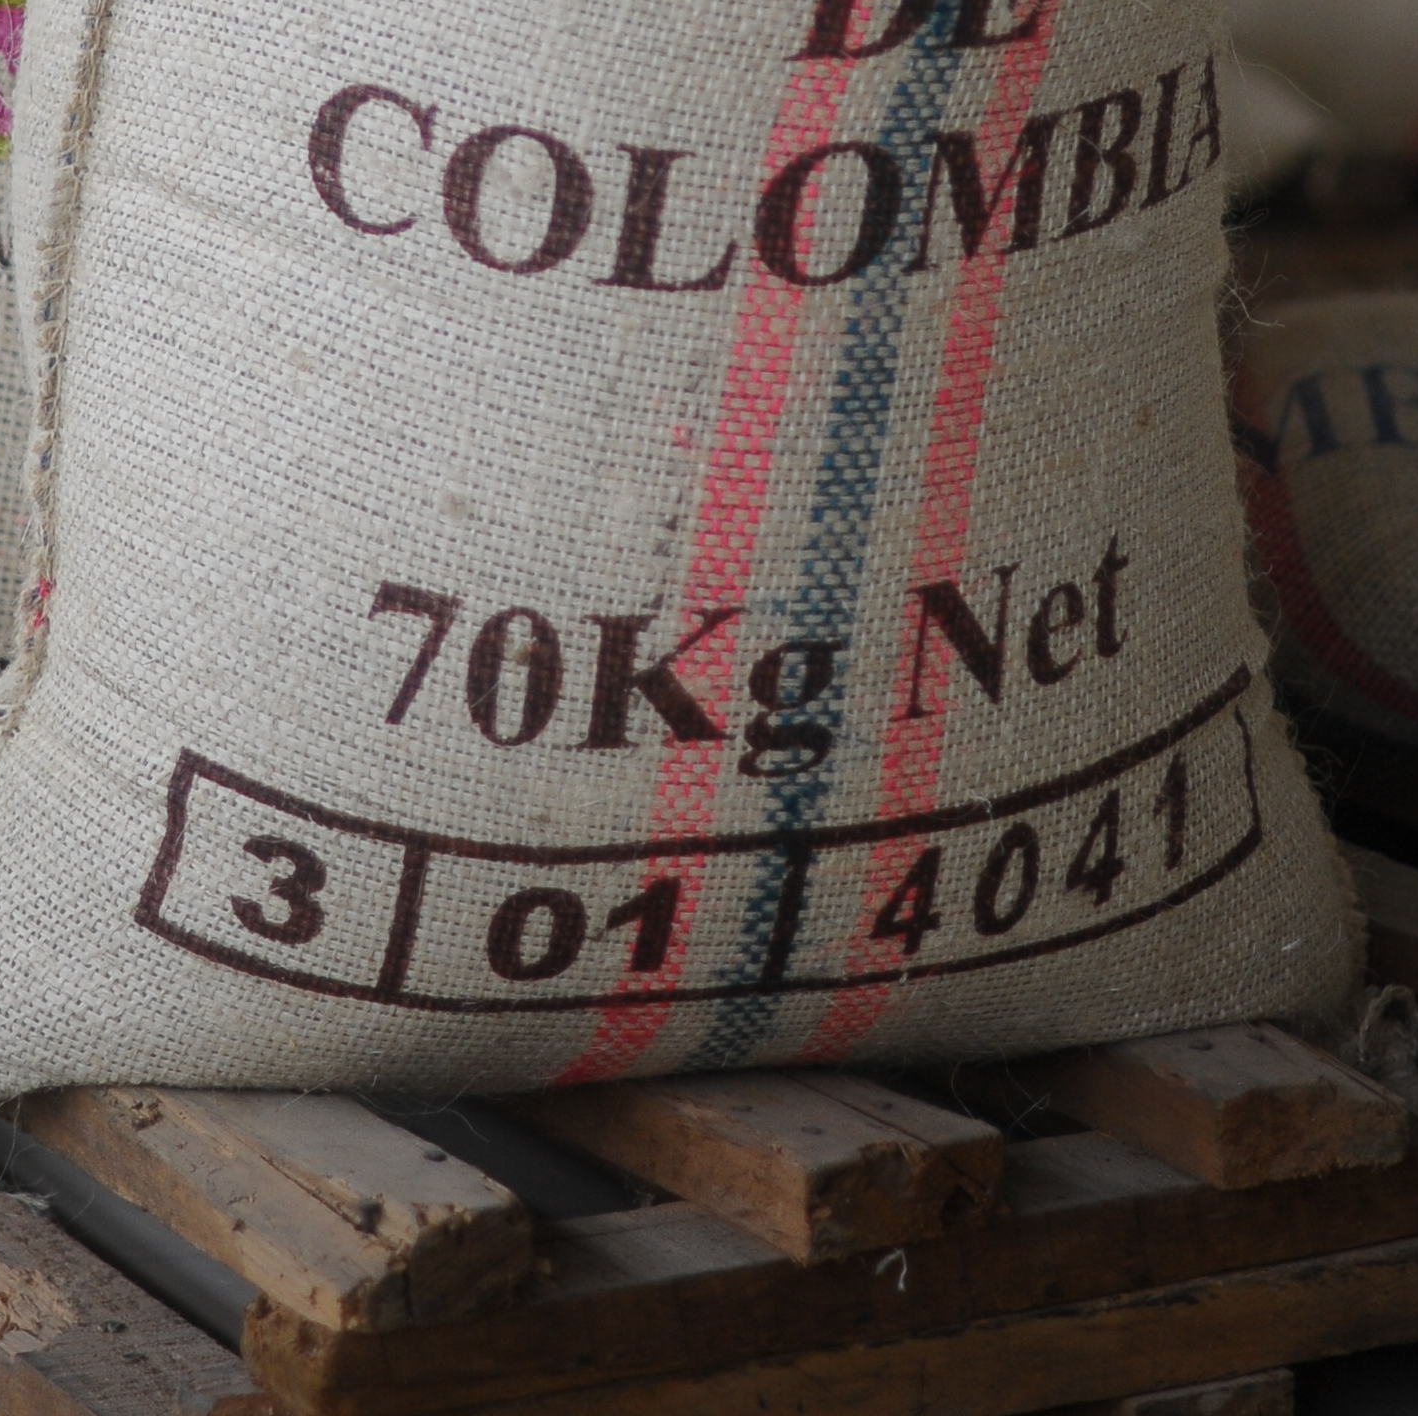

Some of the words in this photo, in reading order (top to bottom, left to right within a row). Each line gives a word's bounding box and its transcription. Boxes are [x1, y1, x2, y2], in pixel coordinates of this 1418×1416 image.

[306, 54, 1223, 291] COLOMBIA
[366, 581, 843, 780] 70Kg
[888, 532, 1131, 721] Net
[231, 837, 329, 945] 3
[486, 876, 684, 982] 01
[871, 754, 1188, 956] 4041
